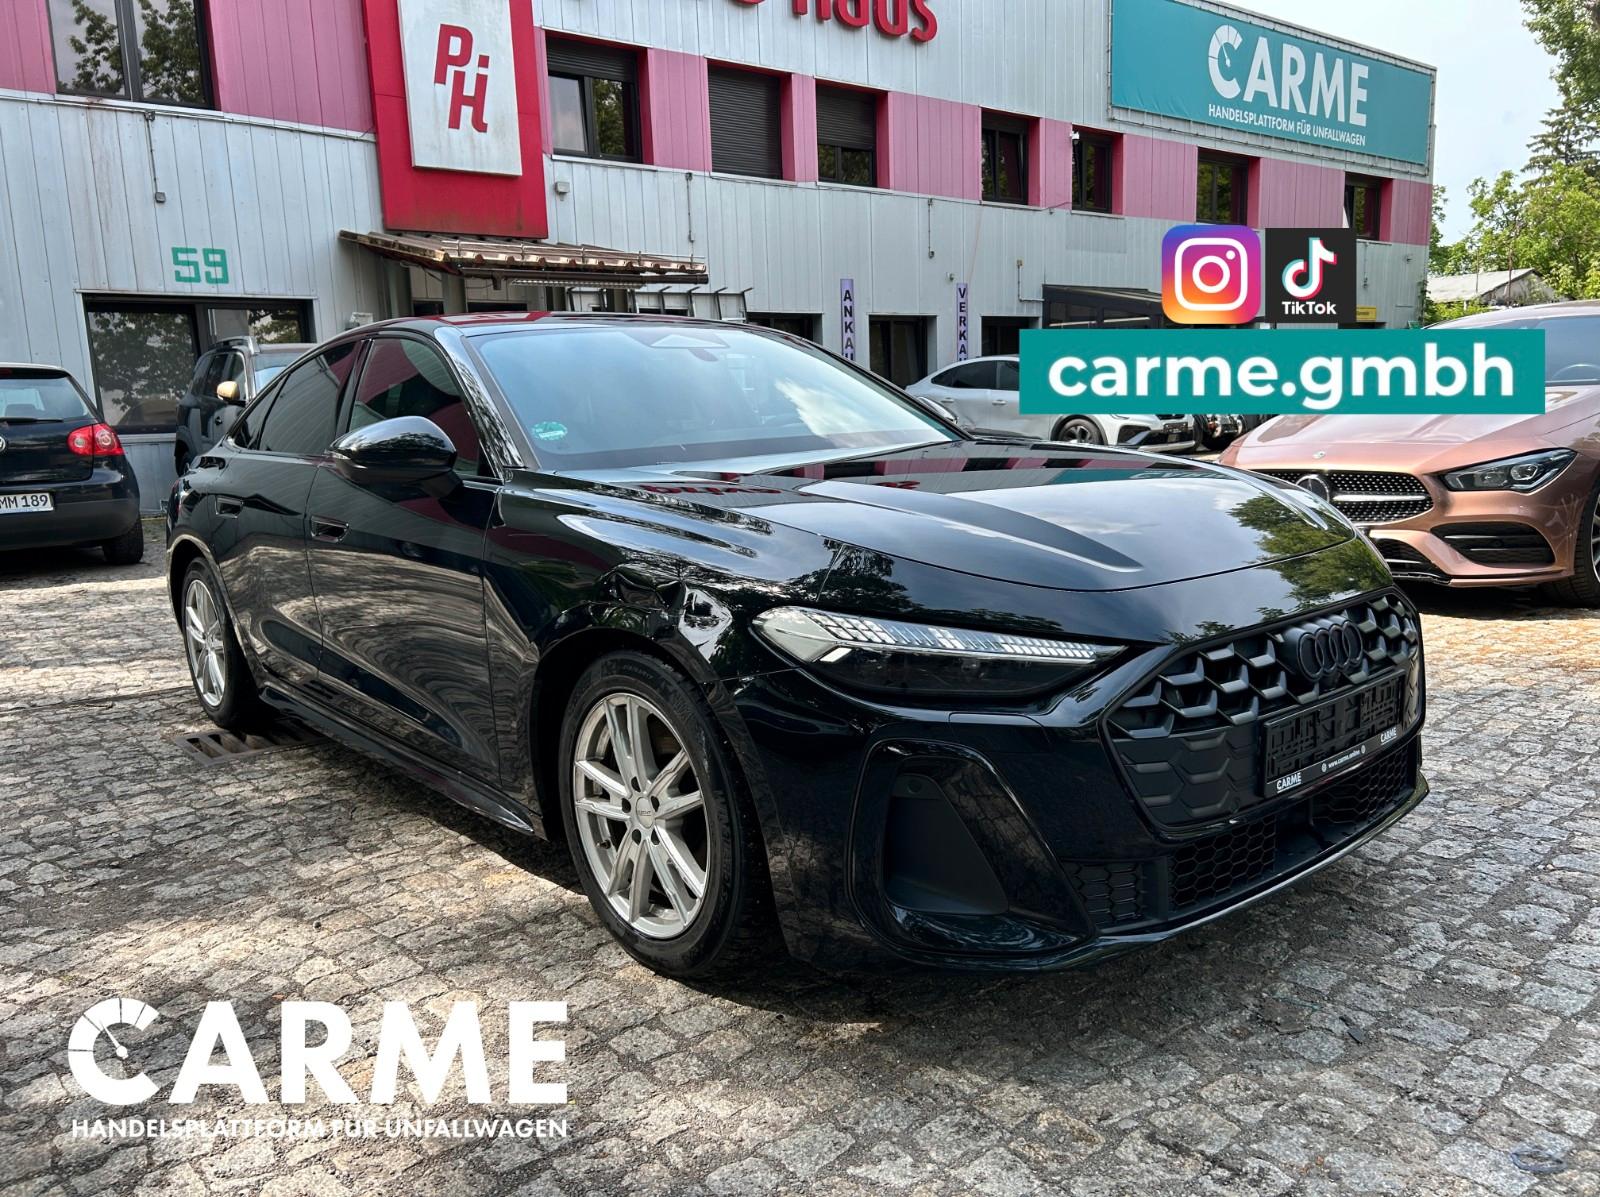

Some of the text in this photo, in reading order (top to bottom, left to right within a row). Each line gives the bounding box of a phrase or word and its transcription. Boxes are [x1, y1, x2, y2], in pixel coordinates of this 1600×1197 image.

[1208, 24, 1369, 127] CARME
[1208, 104, 1366, 147] HANDELSPLATTFORM FÜR UNFALLWAGEN
[172, 246, 229, 285] 59
[21, 494, 48, 508] 189
[1276, 771, 1302, 791] CARME
